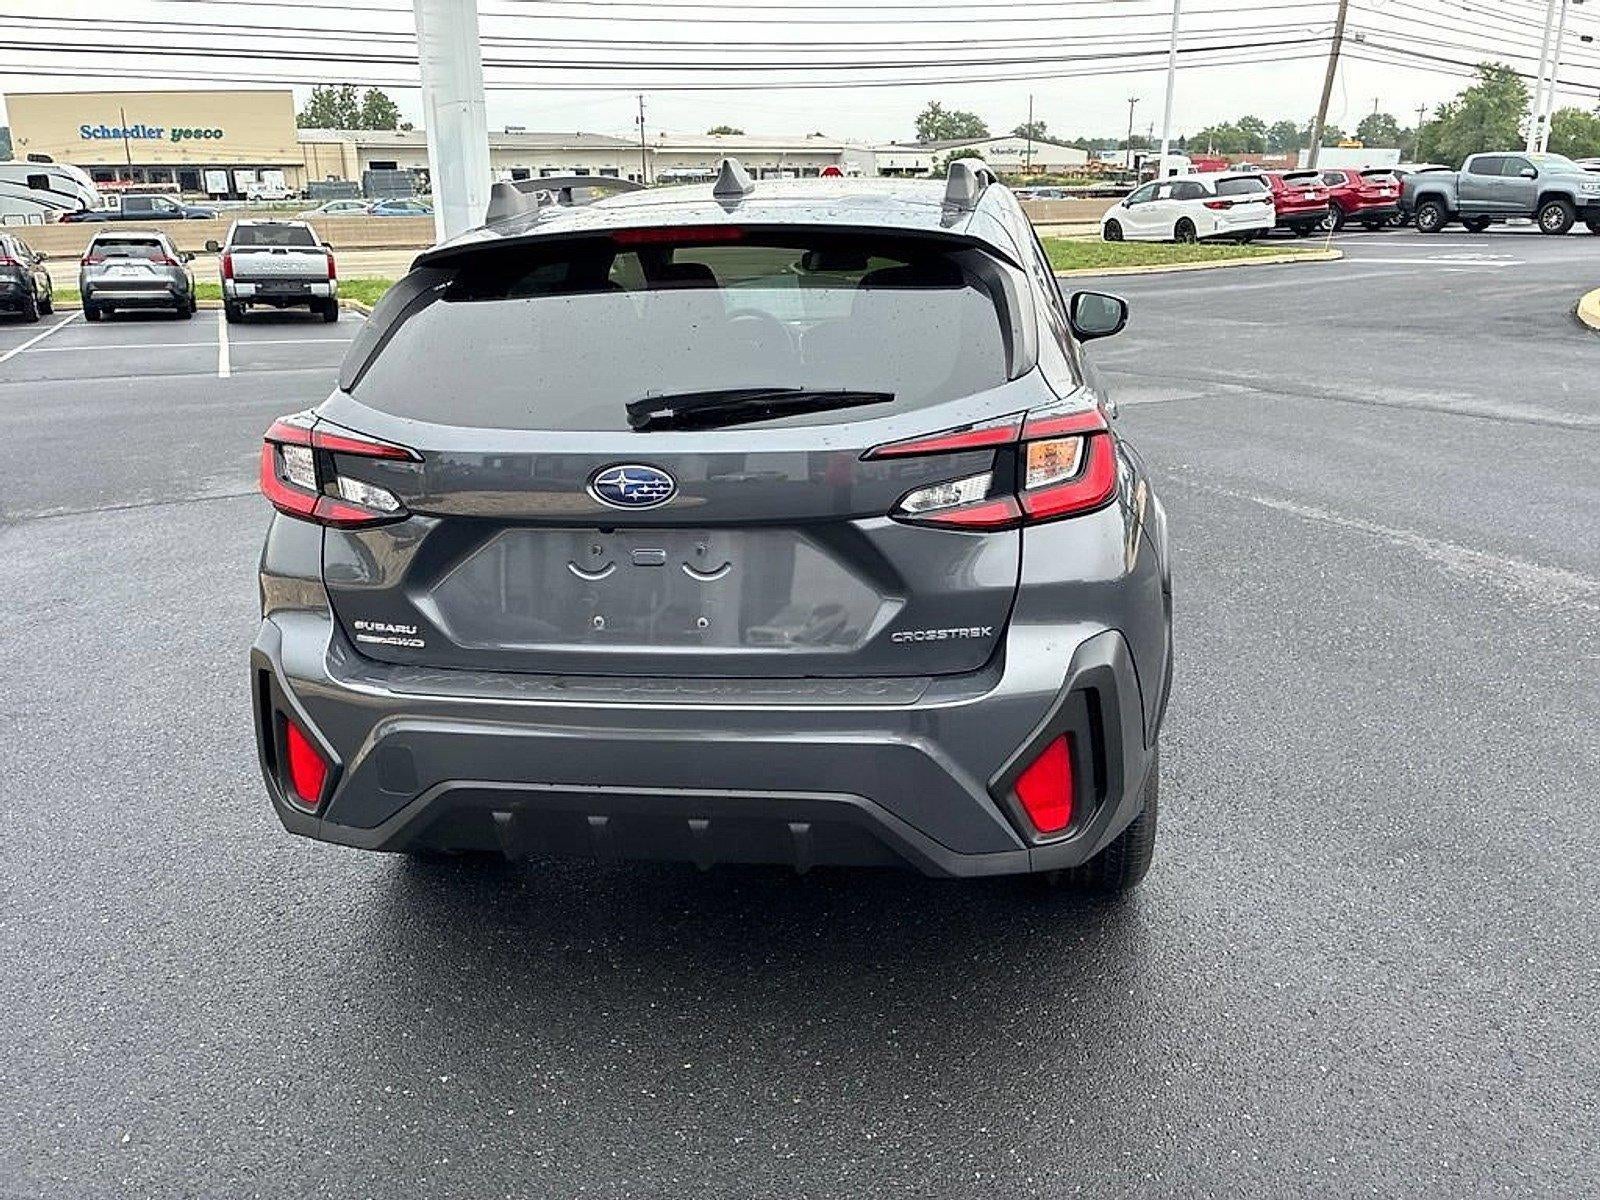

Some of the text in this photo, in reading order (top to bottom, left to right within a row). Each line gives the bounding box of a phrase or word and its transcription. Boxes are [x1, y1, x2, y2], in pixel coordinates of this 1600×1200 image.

[80, 125, 164, 139] Schaedler
[354, 620, 418, 634] SUBARU
[891, 626, 993, 642] CROSSTREK
